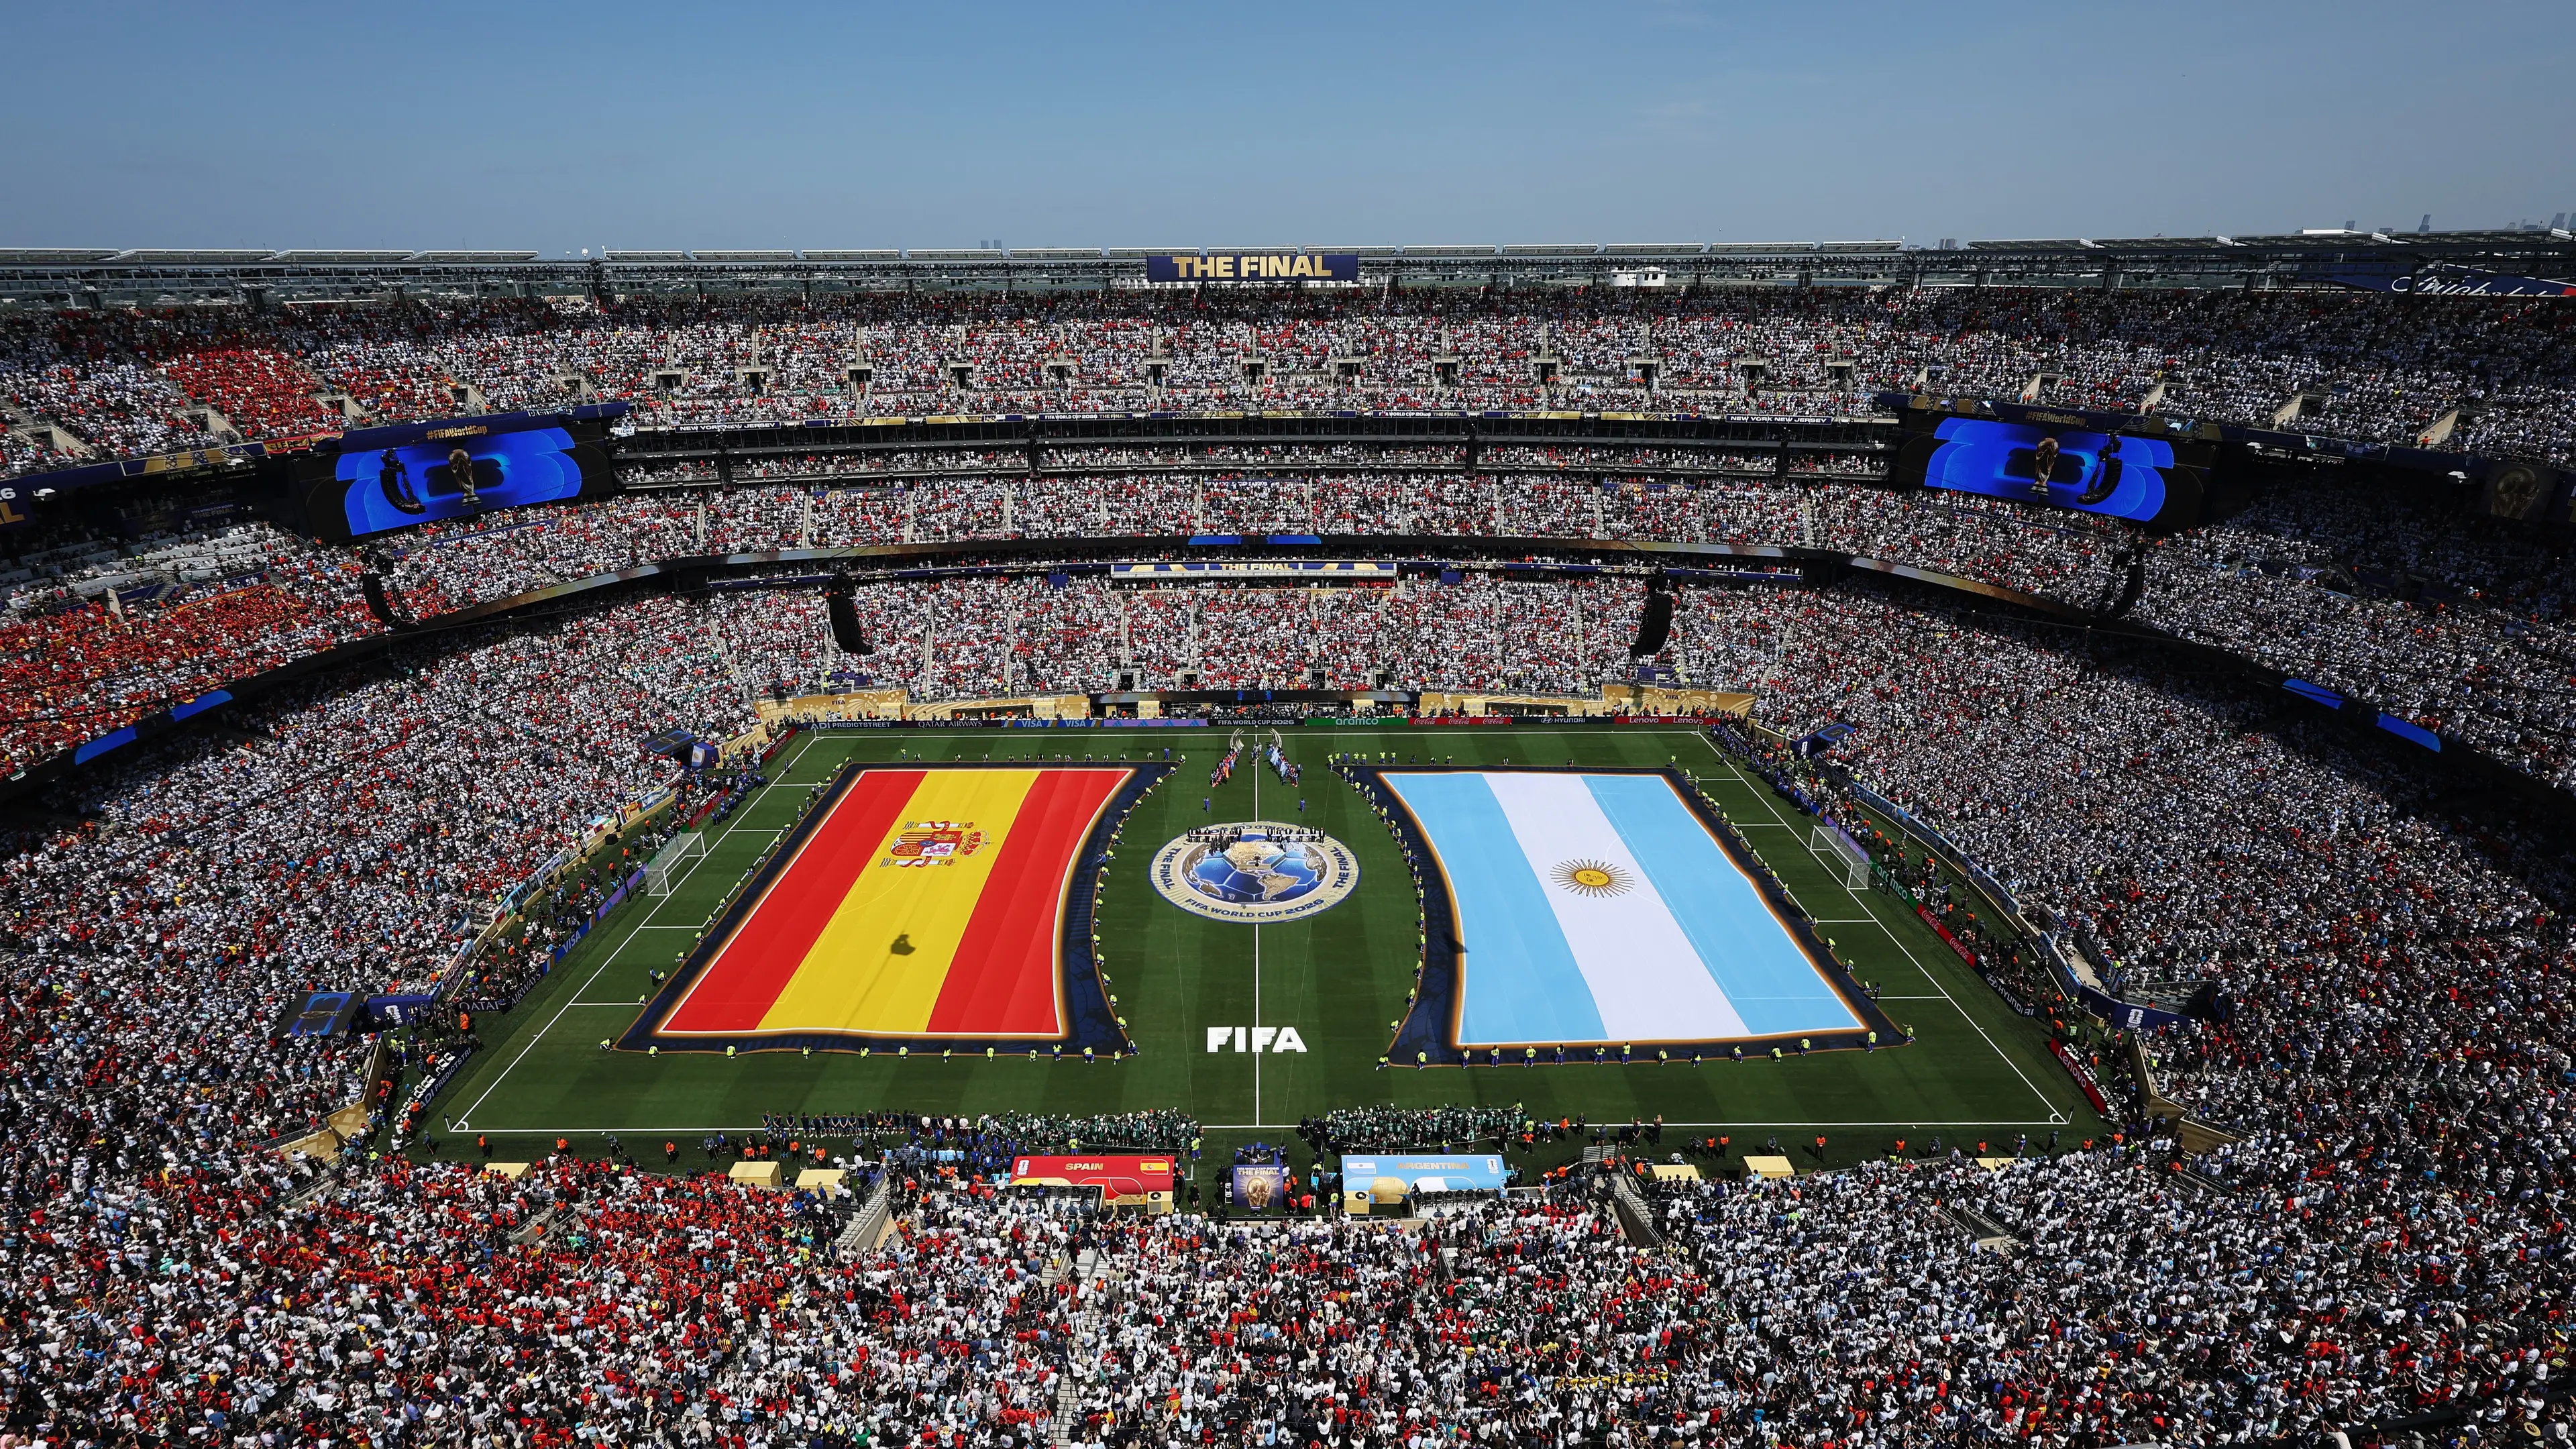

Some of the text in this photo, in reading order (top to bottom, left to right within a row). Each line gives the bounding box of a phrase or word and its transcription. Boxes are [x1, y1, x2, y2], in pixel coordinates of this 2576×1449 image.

[1173, 256, 1332, 277] THE FINAL
[2025, 411, 2086, 427] #FIFAWorldCup
[426, 425, 488, 439] #FIFAWorldCup
[0, 487, 16, 500] 6
[771, 737, 787, 753] Lenovo
[1160, 848, 1182, 890] THE FINAL
[1330, 847, 1350, 888] THE FINAL
[1185, 898, 1208, 912] FIFA
[1211, 907, 1255, 918] WORLD
[1284, 898, 1324, 914] 2026
[561, 930, 581, 953] VISA
[511, 971, 541, 1007] AIRWAYS
[1998, 985, 2034, 1016] HYUNDAI
[1207, 1027, 1307, 1053] FIFA
[434, 1047, 472, 1091] PREDICTSTR
[2058, 1047, 2086, 1088] Lenovo
[1065, 1163, 1104, 1171] SPAIN
